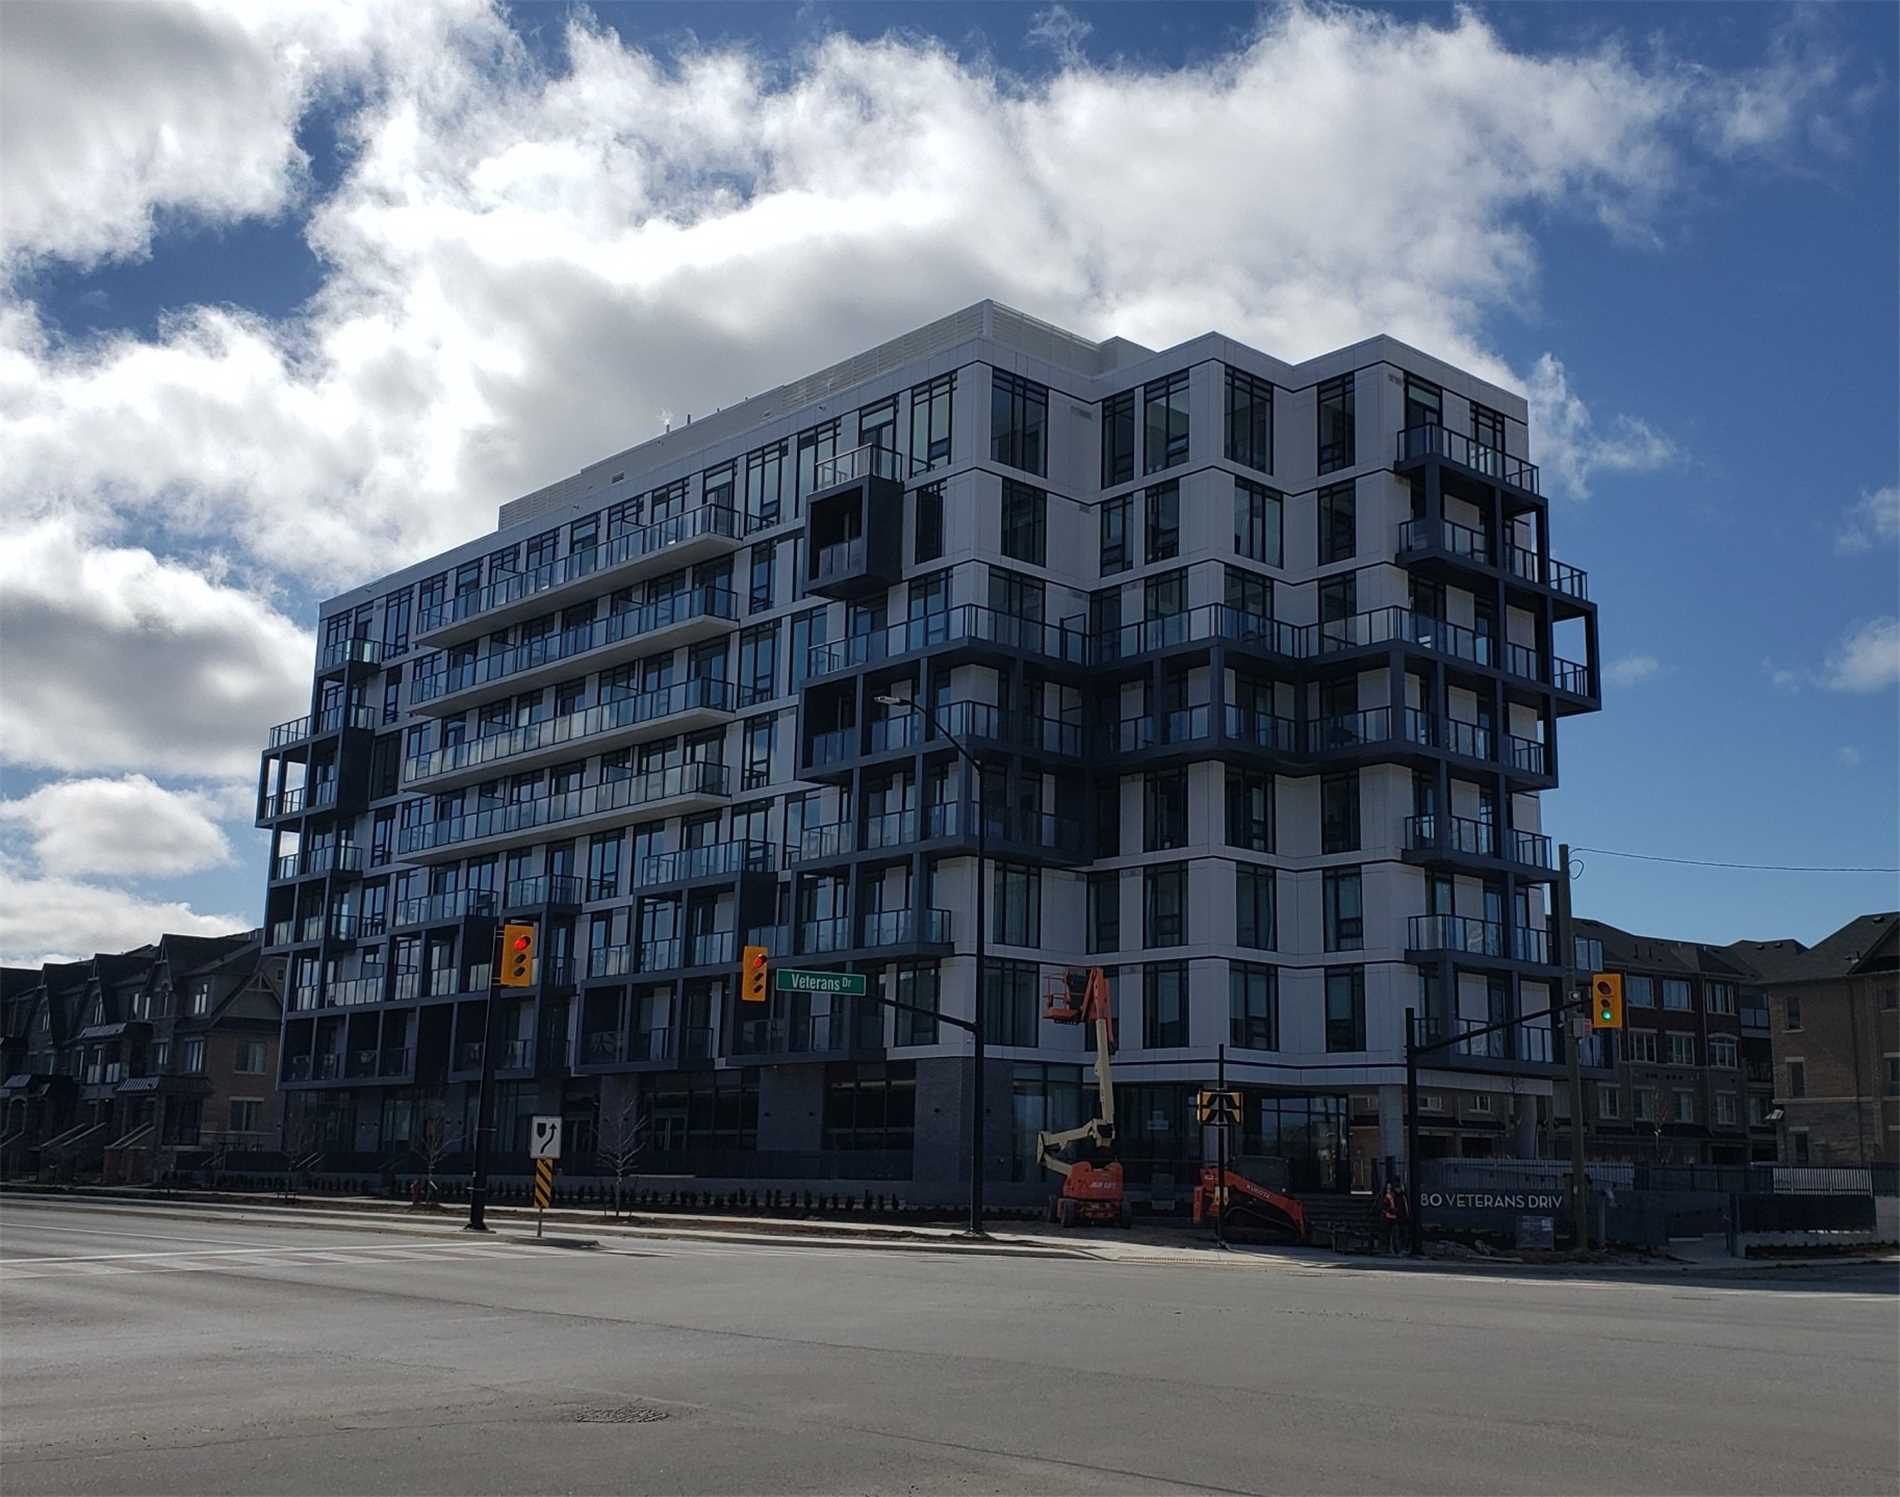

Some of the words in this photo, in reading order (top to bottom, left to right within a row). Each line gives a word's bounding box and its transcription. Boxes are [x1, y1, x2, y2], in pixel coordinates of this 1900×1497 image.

[791, 973, 840, 991] Veterans
[841, 976, 852, 988] Dr
[1445, 1193, 1525, 1209] VETERANS
[1528, 1195, 1563, 1209] DRIV
